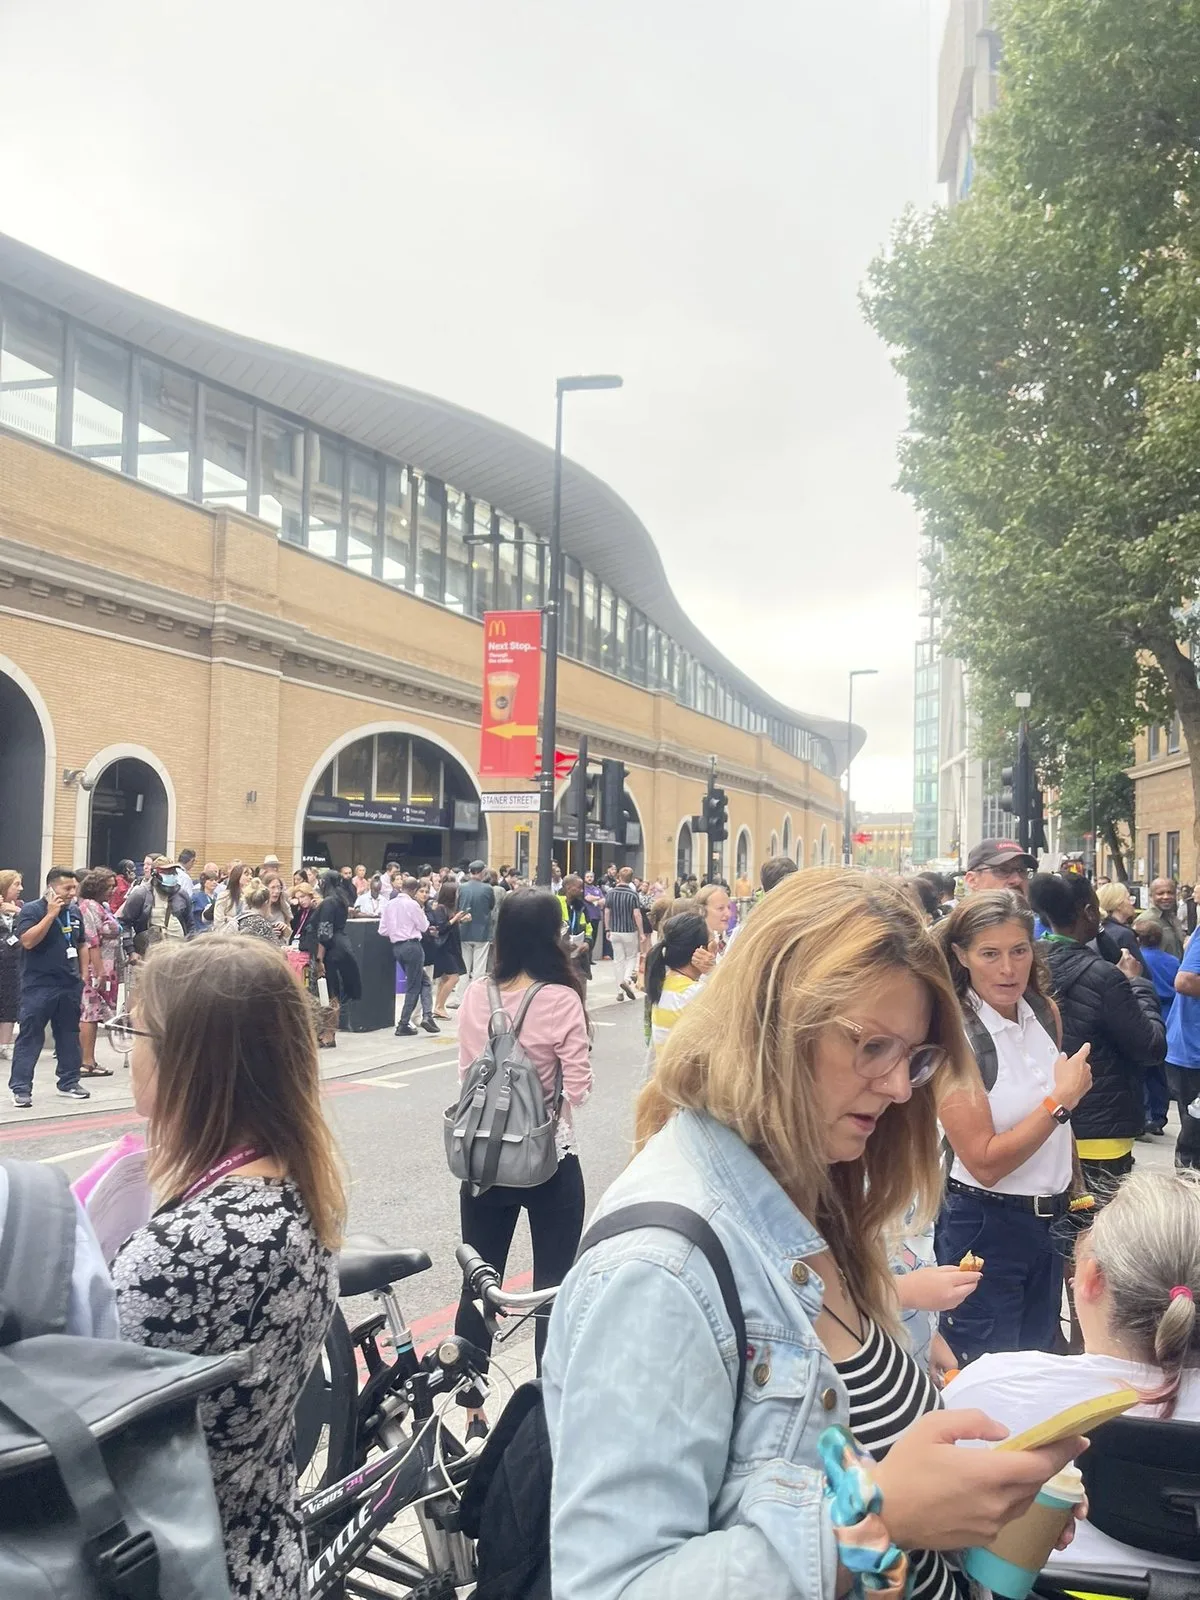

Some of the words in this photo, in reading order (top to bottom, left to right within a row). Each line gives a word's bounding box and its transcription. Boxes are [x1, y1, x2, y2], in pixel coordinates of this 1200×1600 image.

[488, 641, 508, 650] Next
[482, 795, 508, 805] STAINER
[509, 795, 533, 805] STREET
[349, 809, 364, 817] London
[365, 810, 378, 820] Bridge
